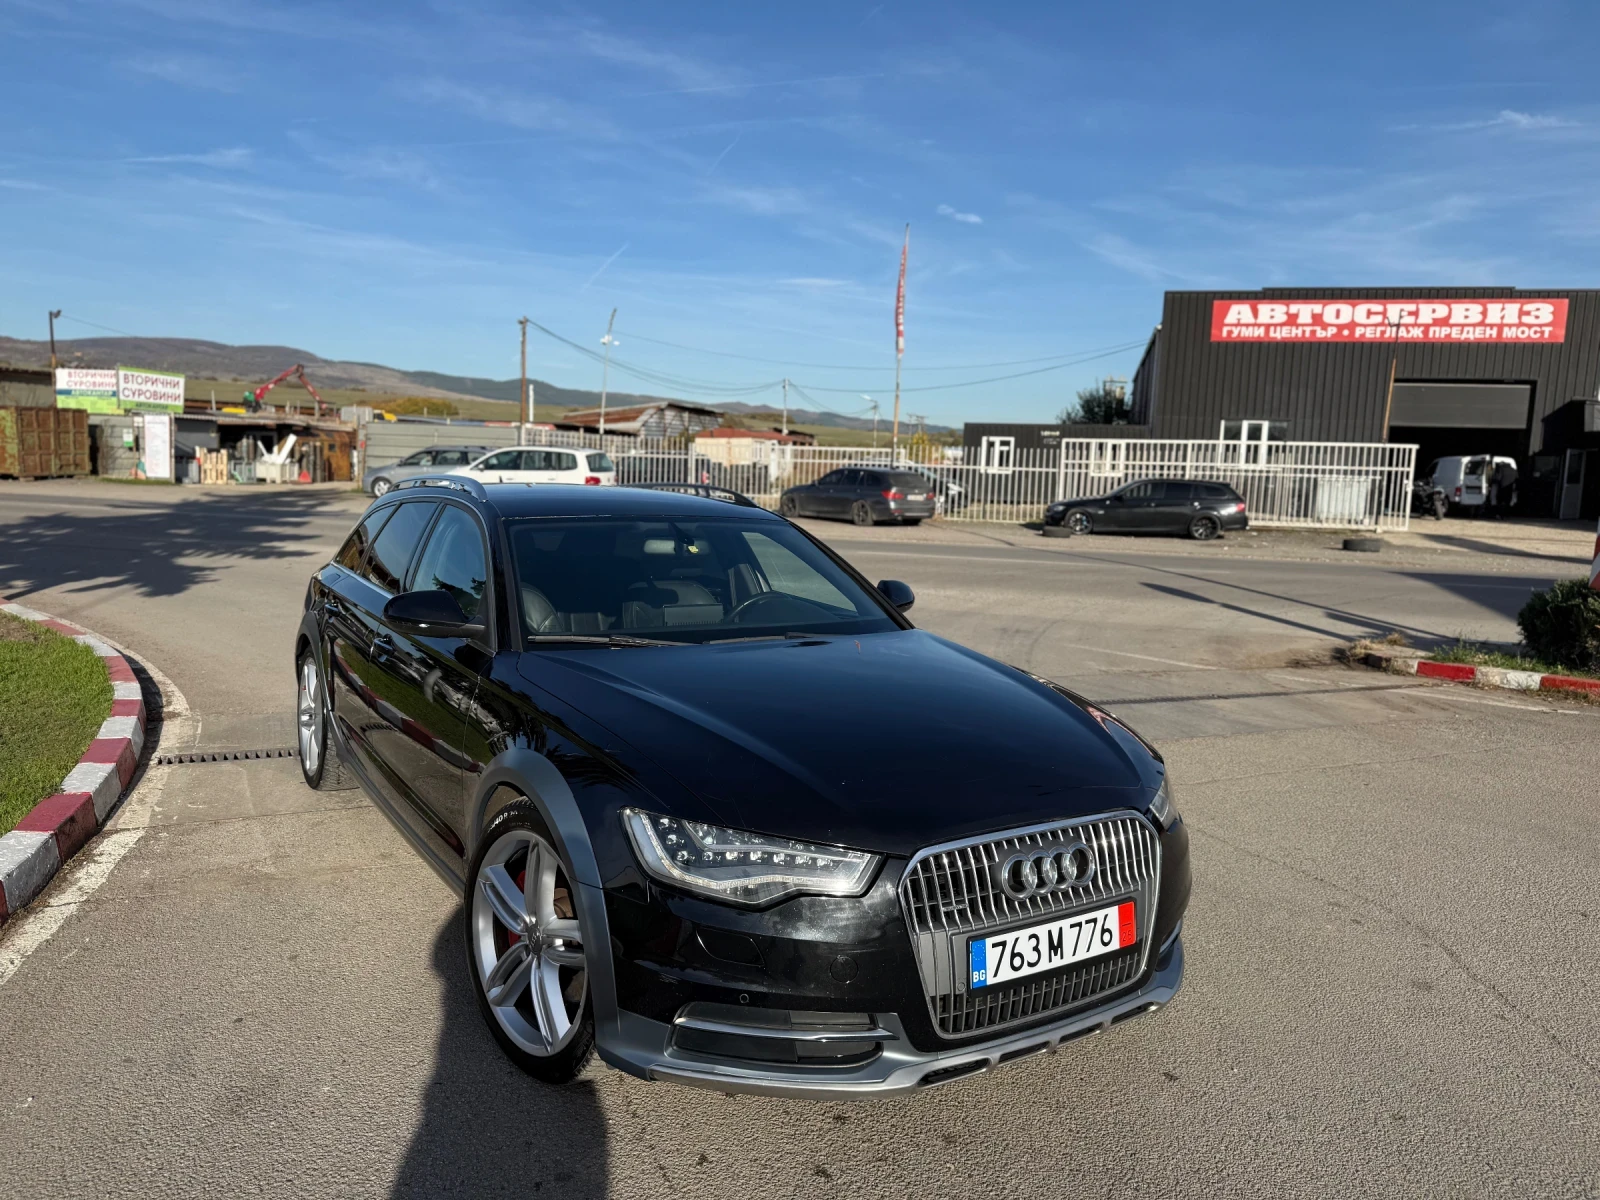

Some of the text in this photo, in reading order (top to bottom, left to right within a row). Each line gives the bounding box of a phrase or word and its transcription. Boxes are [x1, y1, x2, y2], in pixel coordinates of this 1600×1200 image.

[1223, 303, 1555, 325] АВТОСЕРВИЗ
[1221, 326, 1554, 340] ГУМИ ЦЕНТЪР РЕГЛАЖ ПРЕДЕН МОСТ
[123, 373, 180, 389] ВТОРИЧНИ
[122, 387, 181, 402] СУРОВИНИ
[973, 969, 986, 983] BG
